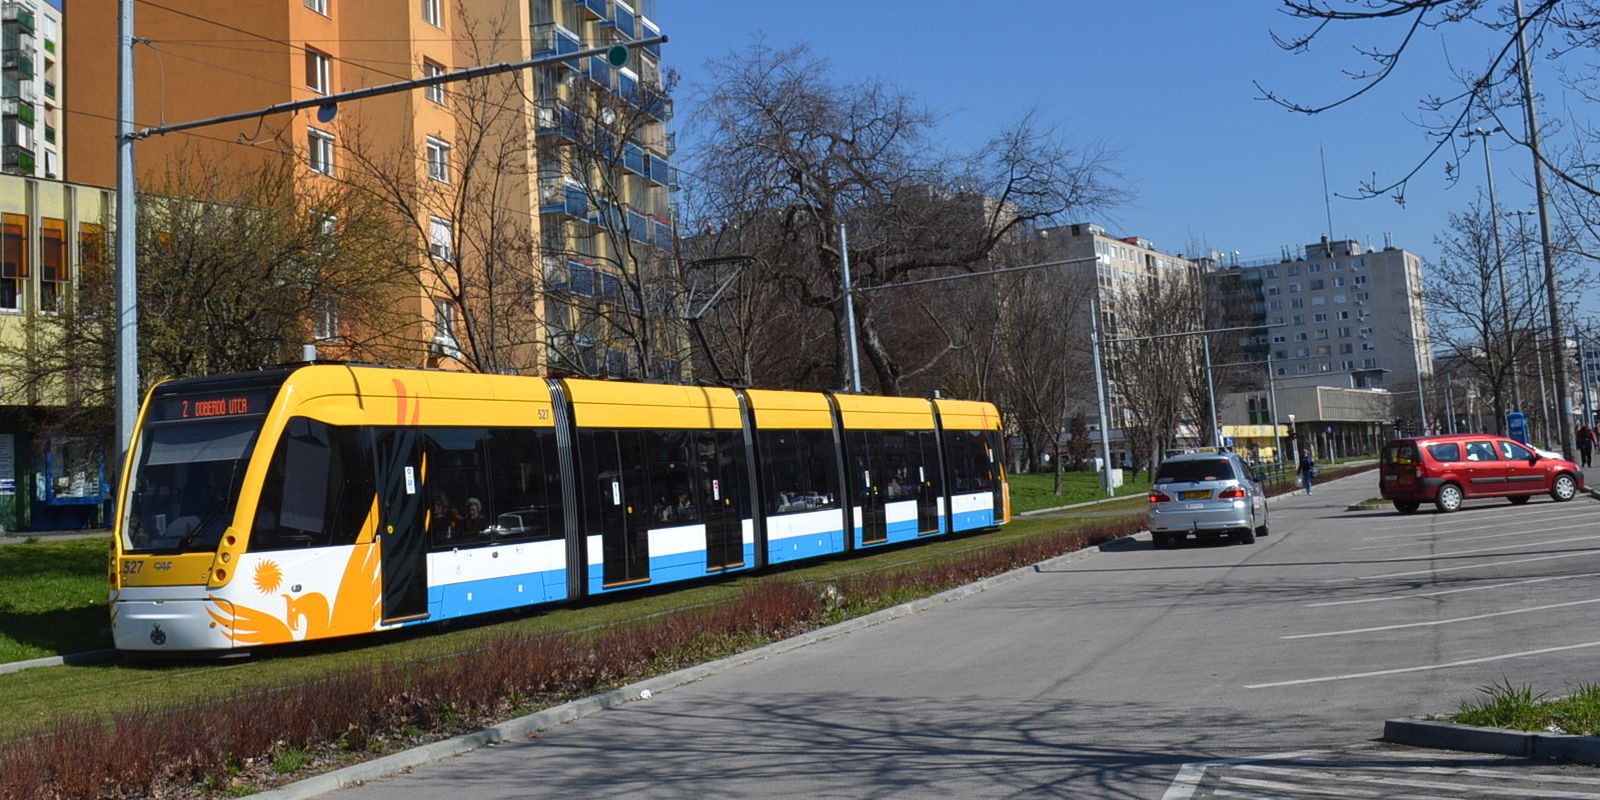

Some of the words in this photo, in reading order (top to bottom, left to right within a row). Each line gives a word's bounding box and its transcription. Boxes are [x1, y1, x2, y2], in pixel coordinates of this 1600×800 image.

[182, 400, 189, 418] 2
[229, 398, 248, 414] UTCA
[537, 408, 549, 420] 527
[123, 560, 144, 574] 527
